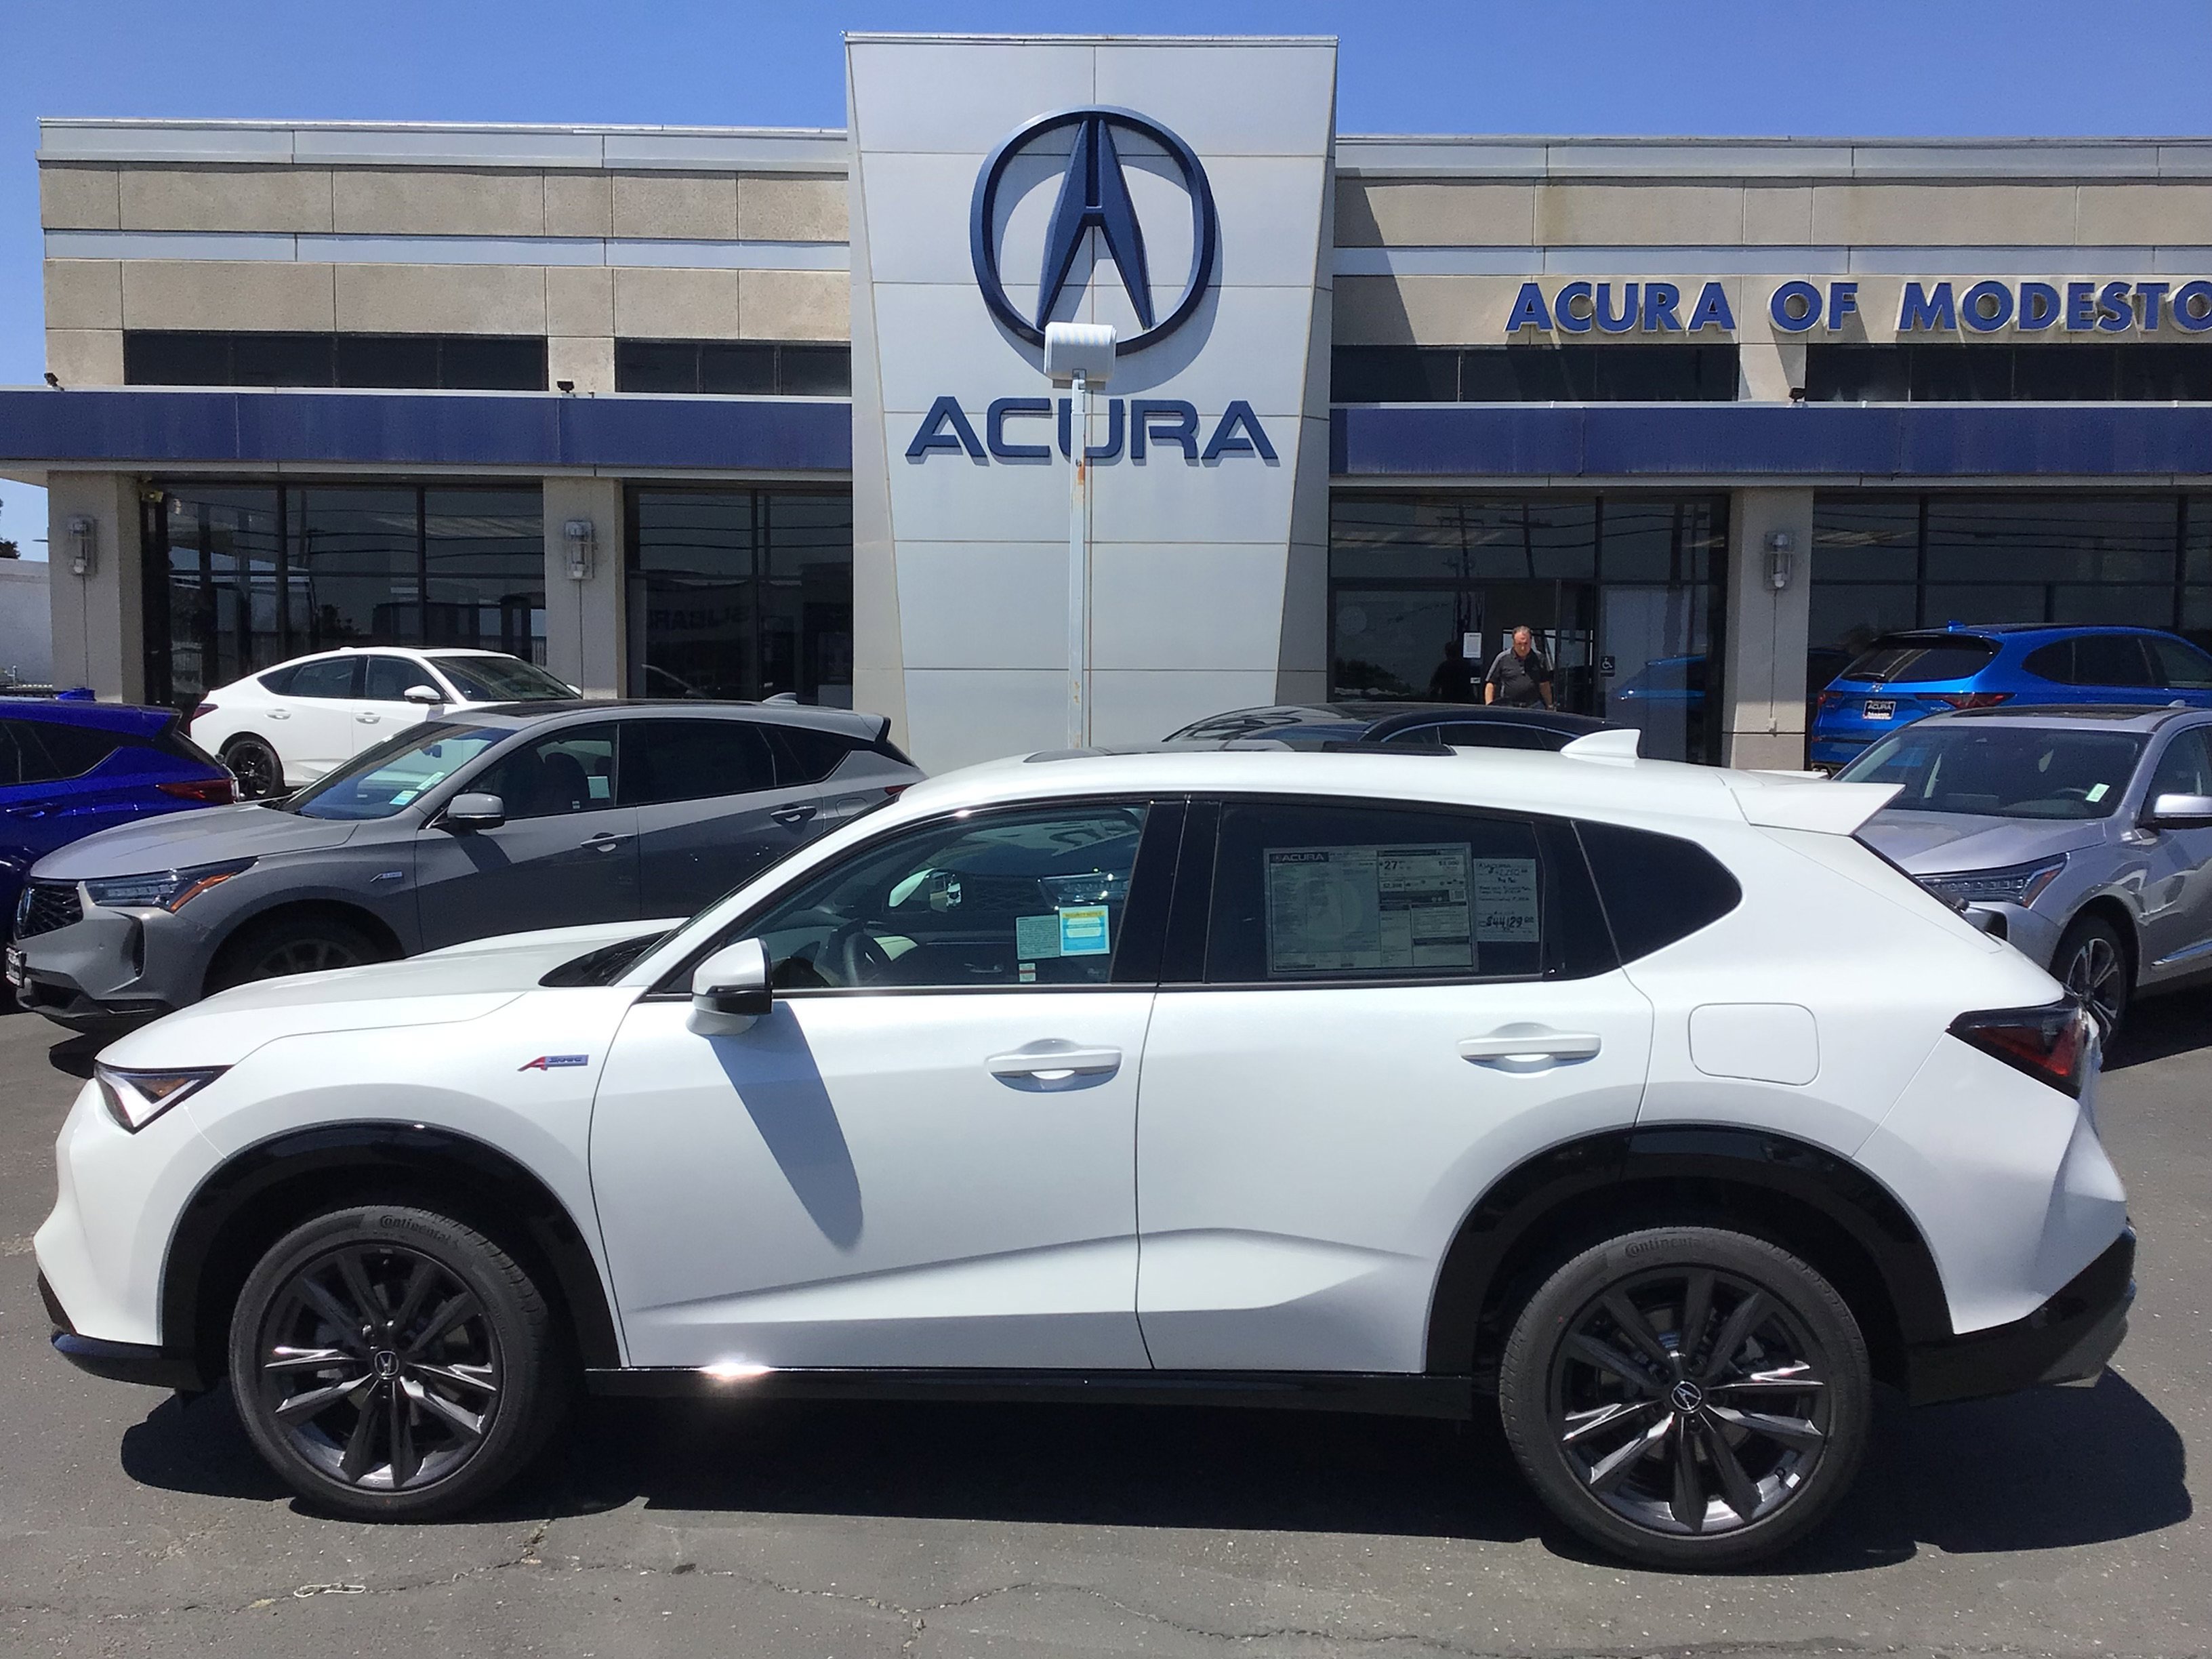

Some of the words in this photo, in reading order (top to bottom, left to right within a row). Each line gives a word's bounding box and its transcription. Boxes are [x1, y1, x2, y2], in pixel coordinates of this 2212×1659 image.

[1506, 281, 1735, 333] ACURA
[1769, 281, 1860, 332] OF
[1899, 280, 2212, 333] MODESTO
[905, 395, 1279, 461] ACURA
[1282, 853, 1324, 861] ACURA
[1384, 861, 1397, 870] 27
[1624, 1237, 1702, 1258] Continenta
